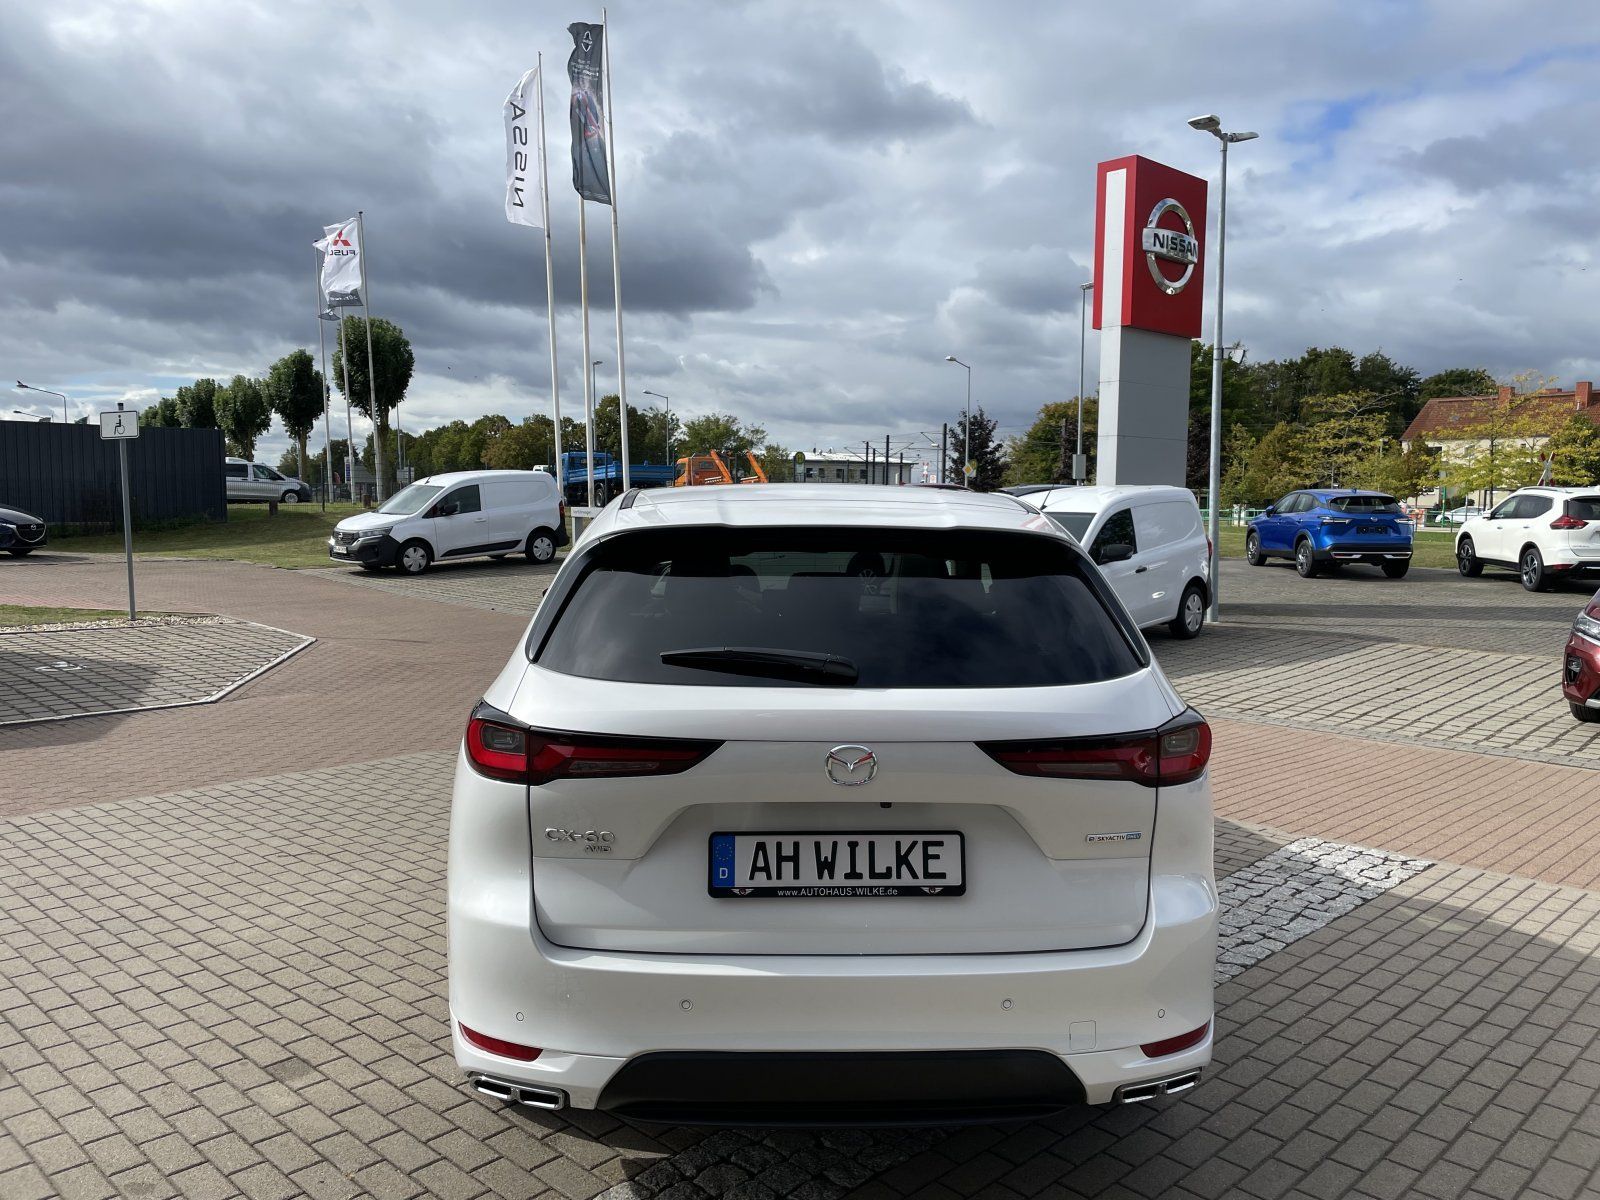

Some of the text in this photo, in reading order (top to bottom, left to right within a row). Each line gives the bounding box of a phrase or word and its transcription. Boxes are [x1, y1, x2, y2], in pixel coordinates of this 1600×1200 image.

[1153, 232, 1198, 257] NISSAN
[544, 827, 616, 843] CX-60
[748, 840, 947, 881] AH WILKE
[719, 867, 729, 879] D
[777, 887, 898, 897] www.AUTOHAUS-WILKE.de
